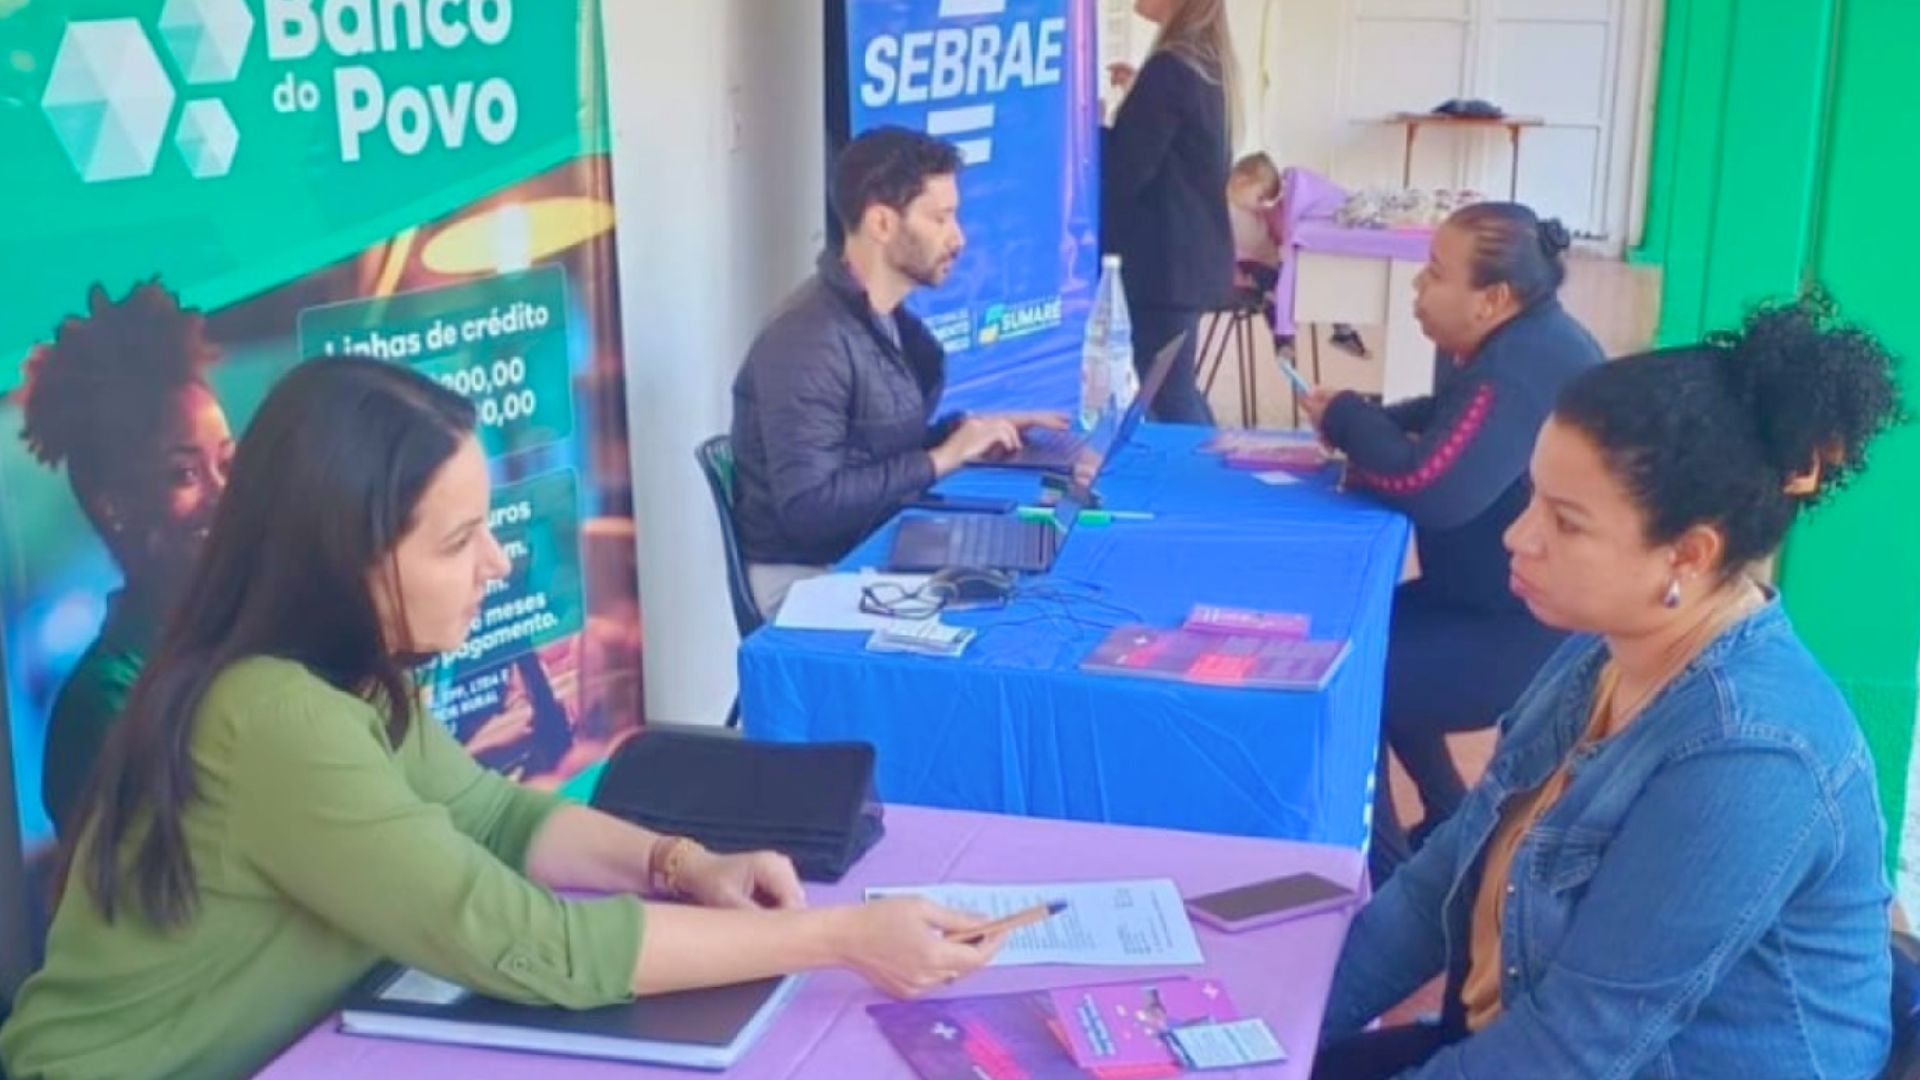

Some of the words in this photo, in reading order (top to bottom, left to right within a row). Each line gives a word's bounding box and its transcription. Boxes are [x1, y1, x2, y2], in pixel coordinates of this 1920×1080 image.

[263, 0, 513, 62] Banco
[859, 17, 1065, 108] SEBRAE
[273, 72, 321, 113] do
[333, 65, 518, 163] Povo
[426, 320, 457, 350] de
[461, 302, 549, 341] crédito
[474, 388, 537, 427] 0,00
[486, 592, 547, 626] meses
